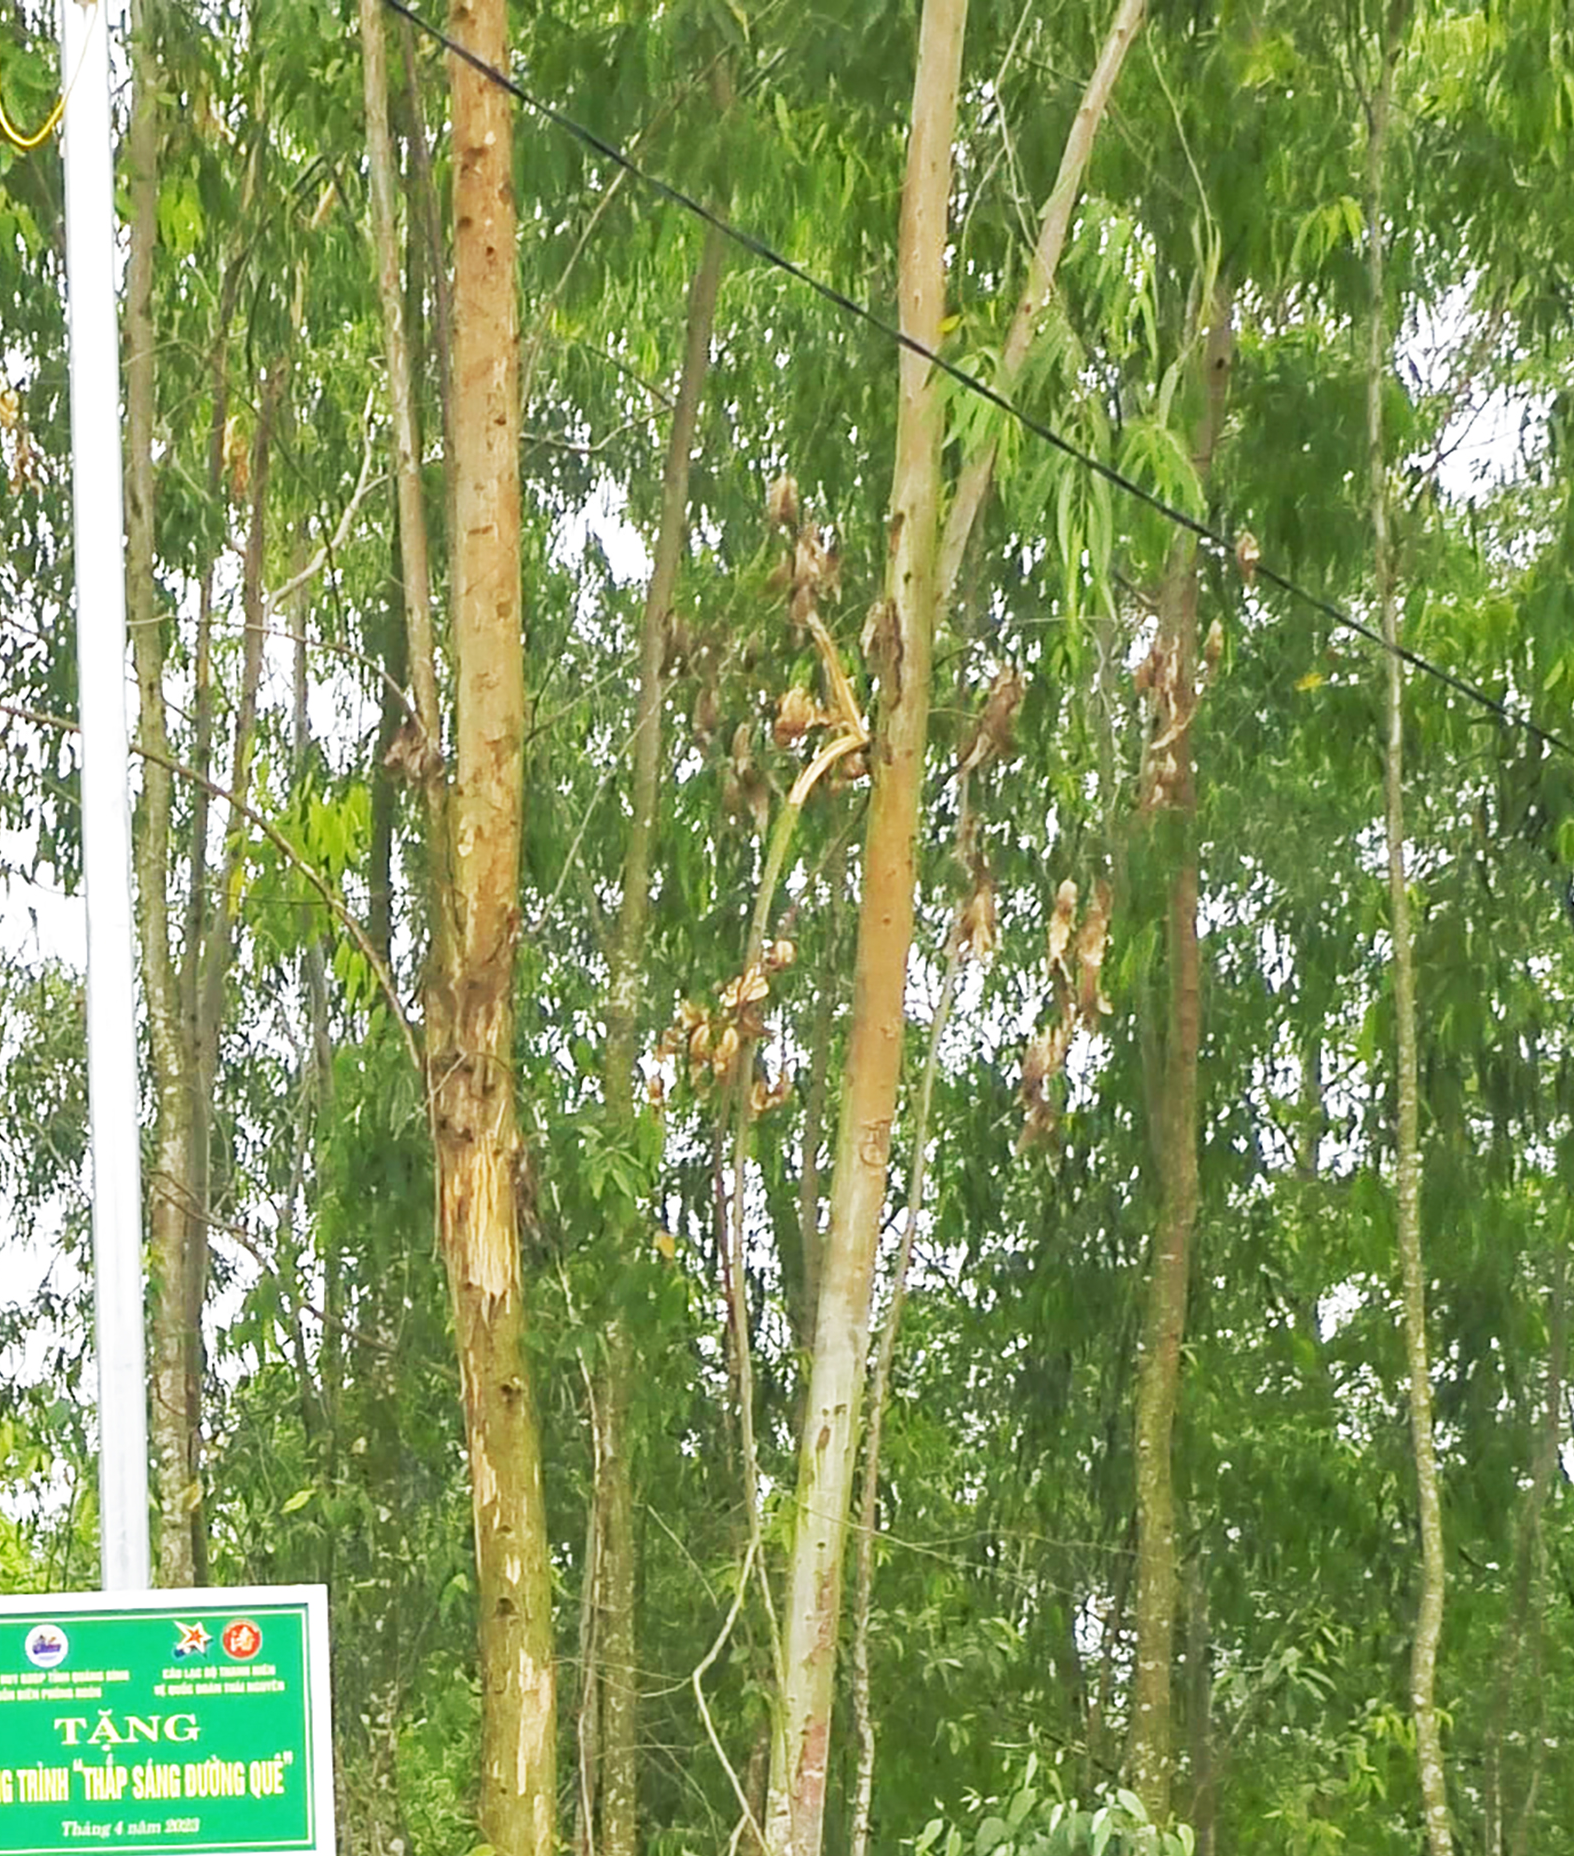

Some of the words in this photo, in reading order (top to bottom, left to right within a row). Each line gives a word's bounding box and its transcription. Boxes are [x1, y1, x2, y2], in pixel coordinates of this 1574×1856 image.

[54, 1708, 201, 1751] TẶNG
[16, 1761, 69, 1802] TRÌNH
[132, 1758, 181, 1799] SÁNG
[184, 1754, 246, 1798] ĐƯỜNG
[61, 1820, 112, 1839] Tháng
[114, 1820, 123, 1836] 4
[127, 1819, 161, 1835] năm
